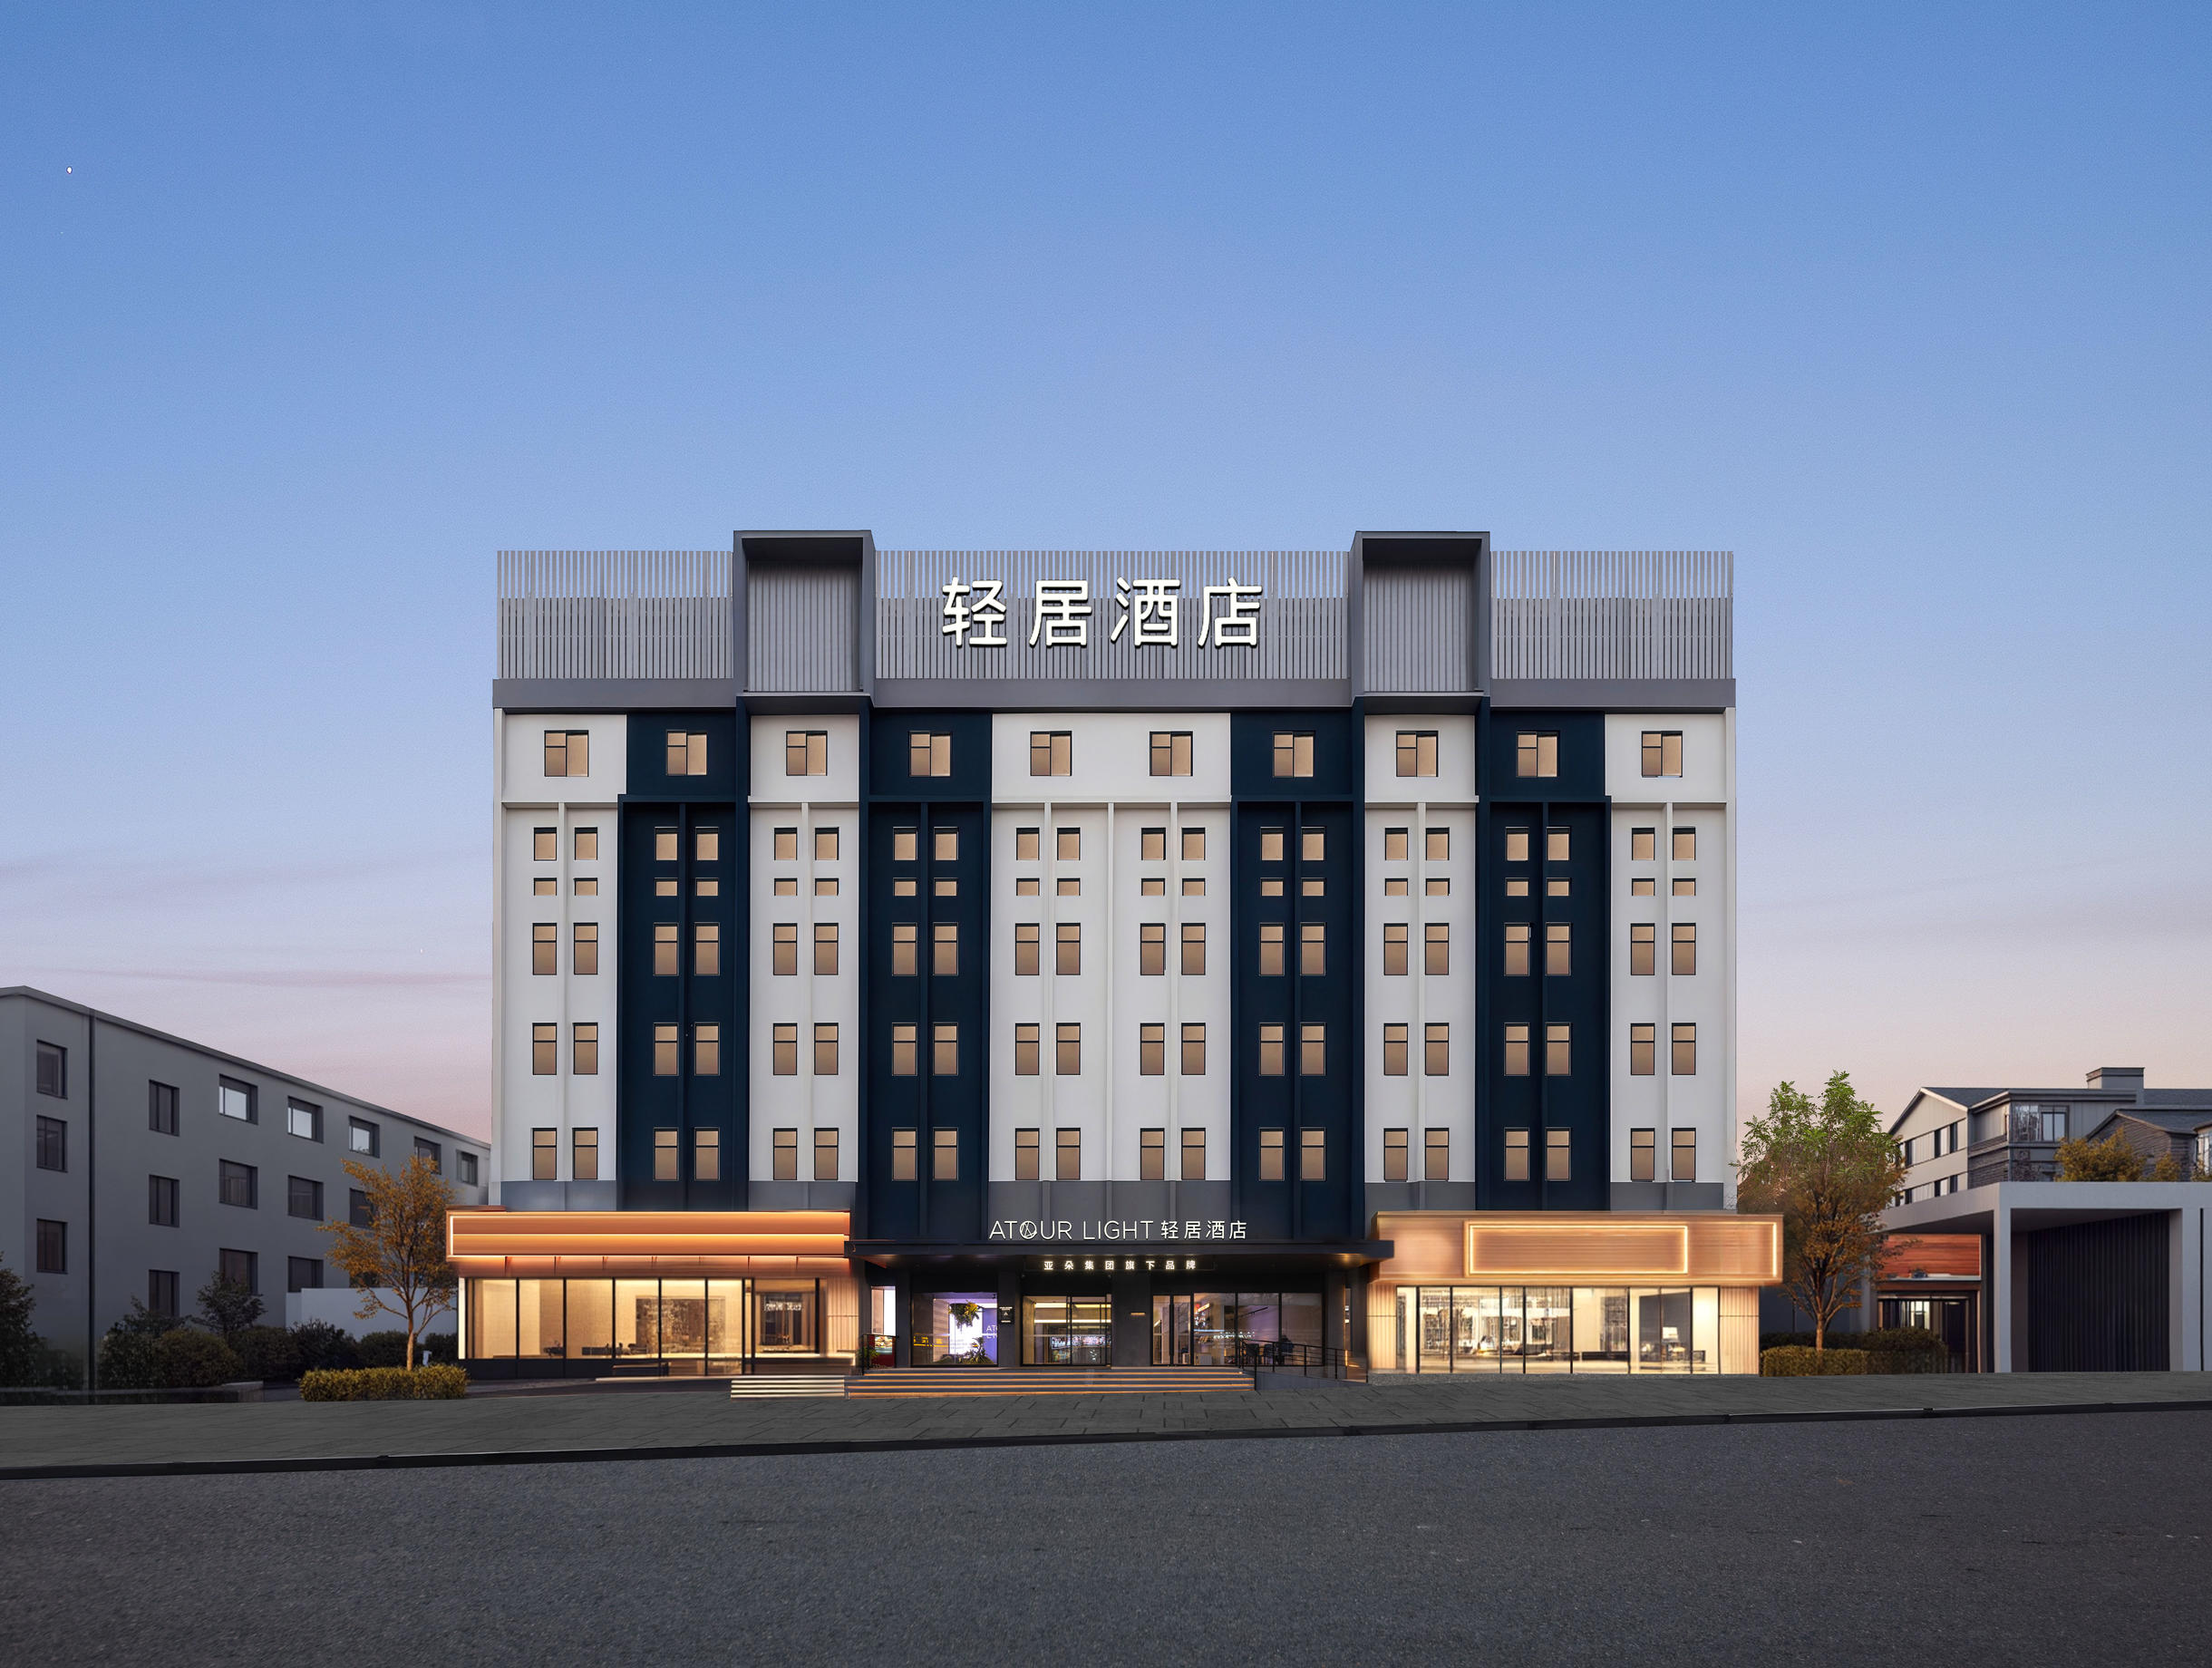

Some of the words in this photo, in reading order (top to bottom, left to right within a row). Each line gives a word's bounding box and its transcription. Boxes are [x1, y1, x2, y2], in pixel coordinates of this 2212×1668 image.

[942, 576, 1263, 646] 轻居酒店
[988, 1220, 1072, 1240] ATOUR
[1082, 1220, 1154, 1240] LIGHT
[1160, 1219, 1247, 1239] 轻居酒店
[1043, 1259, 1197, 1271] 亚朵集团旗下品牌
